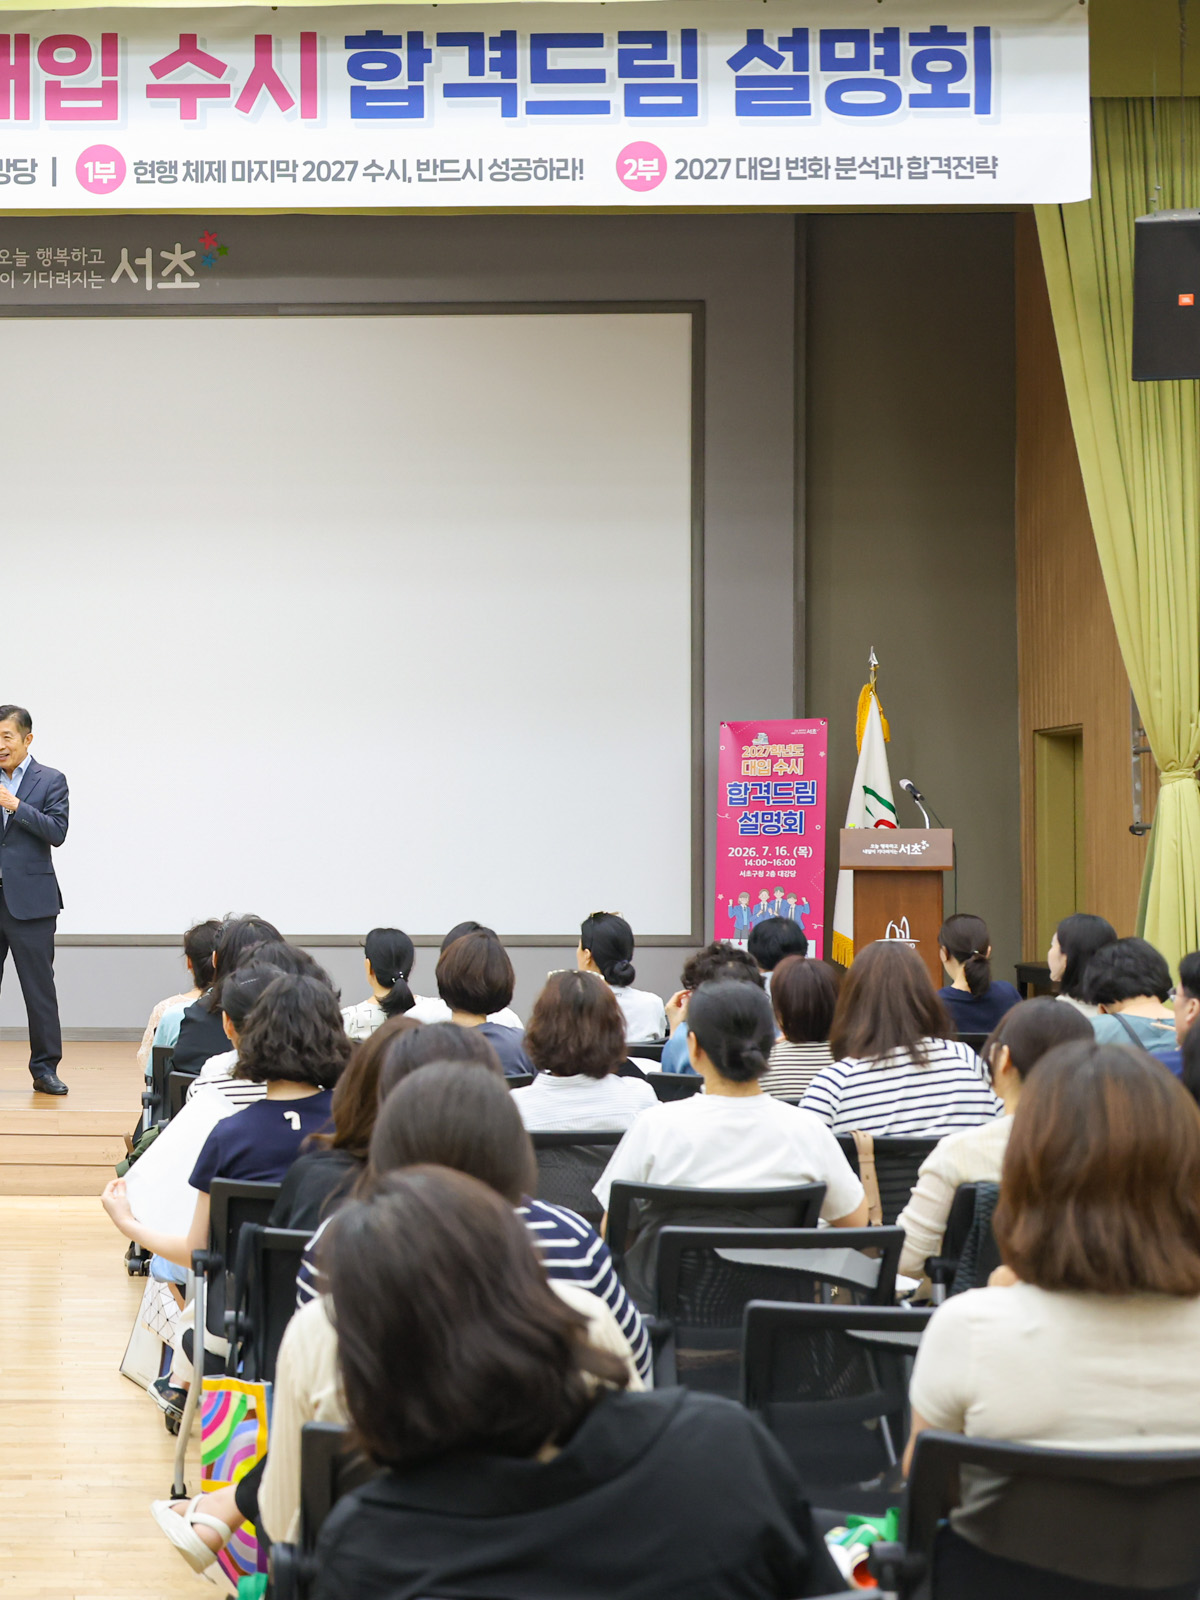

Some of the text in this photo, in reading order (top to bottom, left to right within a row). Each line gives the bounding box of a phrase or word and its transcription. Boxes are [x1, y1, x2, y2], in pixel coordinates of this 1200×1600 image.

[146, 32, 318, 120] 수시
[344, 28, 699, 120] 합격드림
[726, 25, 992, 118] 설명회
[84, 158, 117, 185] 1부
[134, 158, 583, 184] 현행 체제 마지막 2027 수시, 반드시 성공하라!
[623, 157, 660, 183] 2부
[675, 156, 998, 180] 2027 대입 변화 분석과 합격전략
[36, 247, 105, 267] 행복하고
[111, 243, 200, 290] 서초
[23, 270, 105, 289] 기다려지는
[742, 744, 804, 758] 2027학년도
[742, 758, 804, 776] 대입 수시
[727, 780, 817, 806] 합격드림
[738, 810, 804, 835] 설명회
[728, 846, 813, 858] 2026. 7. 16. (목)
[898, 843, 922, 855] 서초
